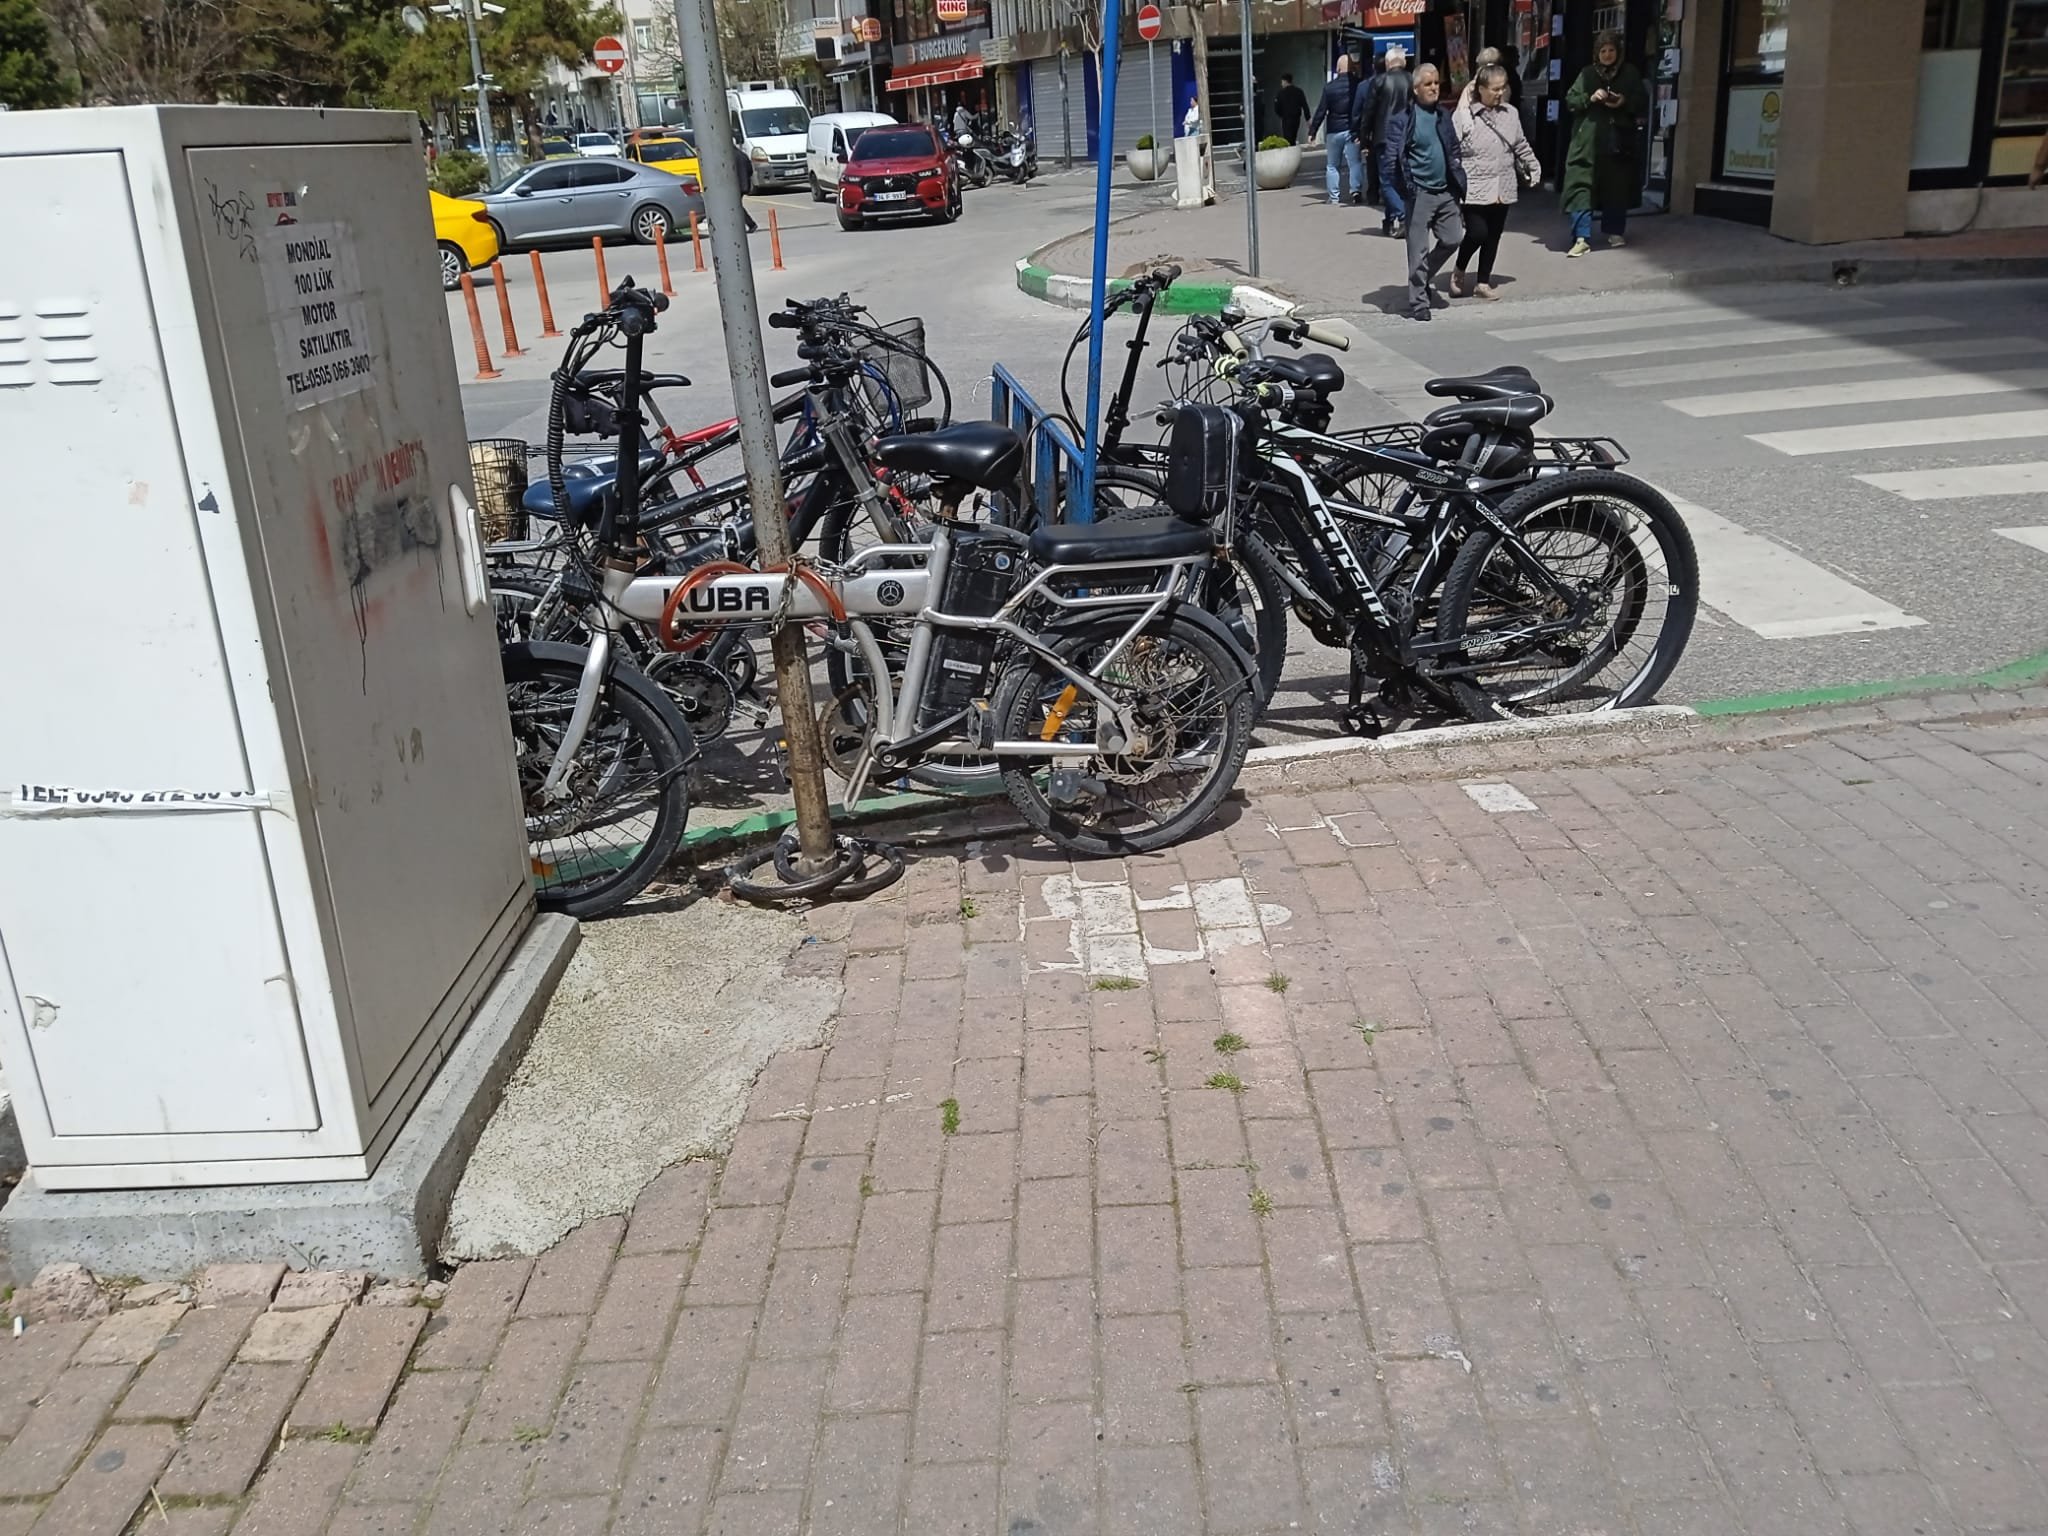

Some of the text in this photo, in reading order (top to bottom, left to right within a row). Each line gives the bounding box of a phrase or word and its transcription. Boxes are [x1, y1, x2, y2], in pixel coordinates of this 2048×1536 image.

[938, 1, 966, 13] KING
[920, 33, 967, 62] BURGER KING
[286, 235, 331, 264] MONDİAL
[295, 268, 335, 295] 100 LÜK
[302, 301, 337, 326] MOTOR
[299, 328, 353, 360] SATILIKTIR
[333, 361, 350, 382] 066
[1415, 469, 1449, 485] SNOOP
